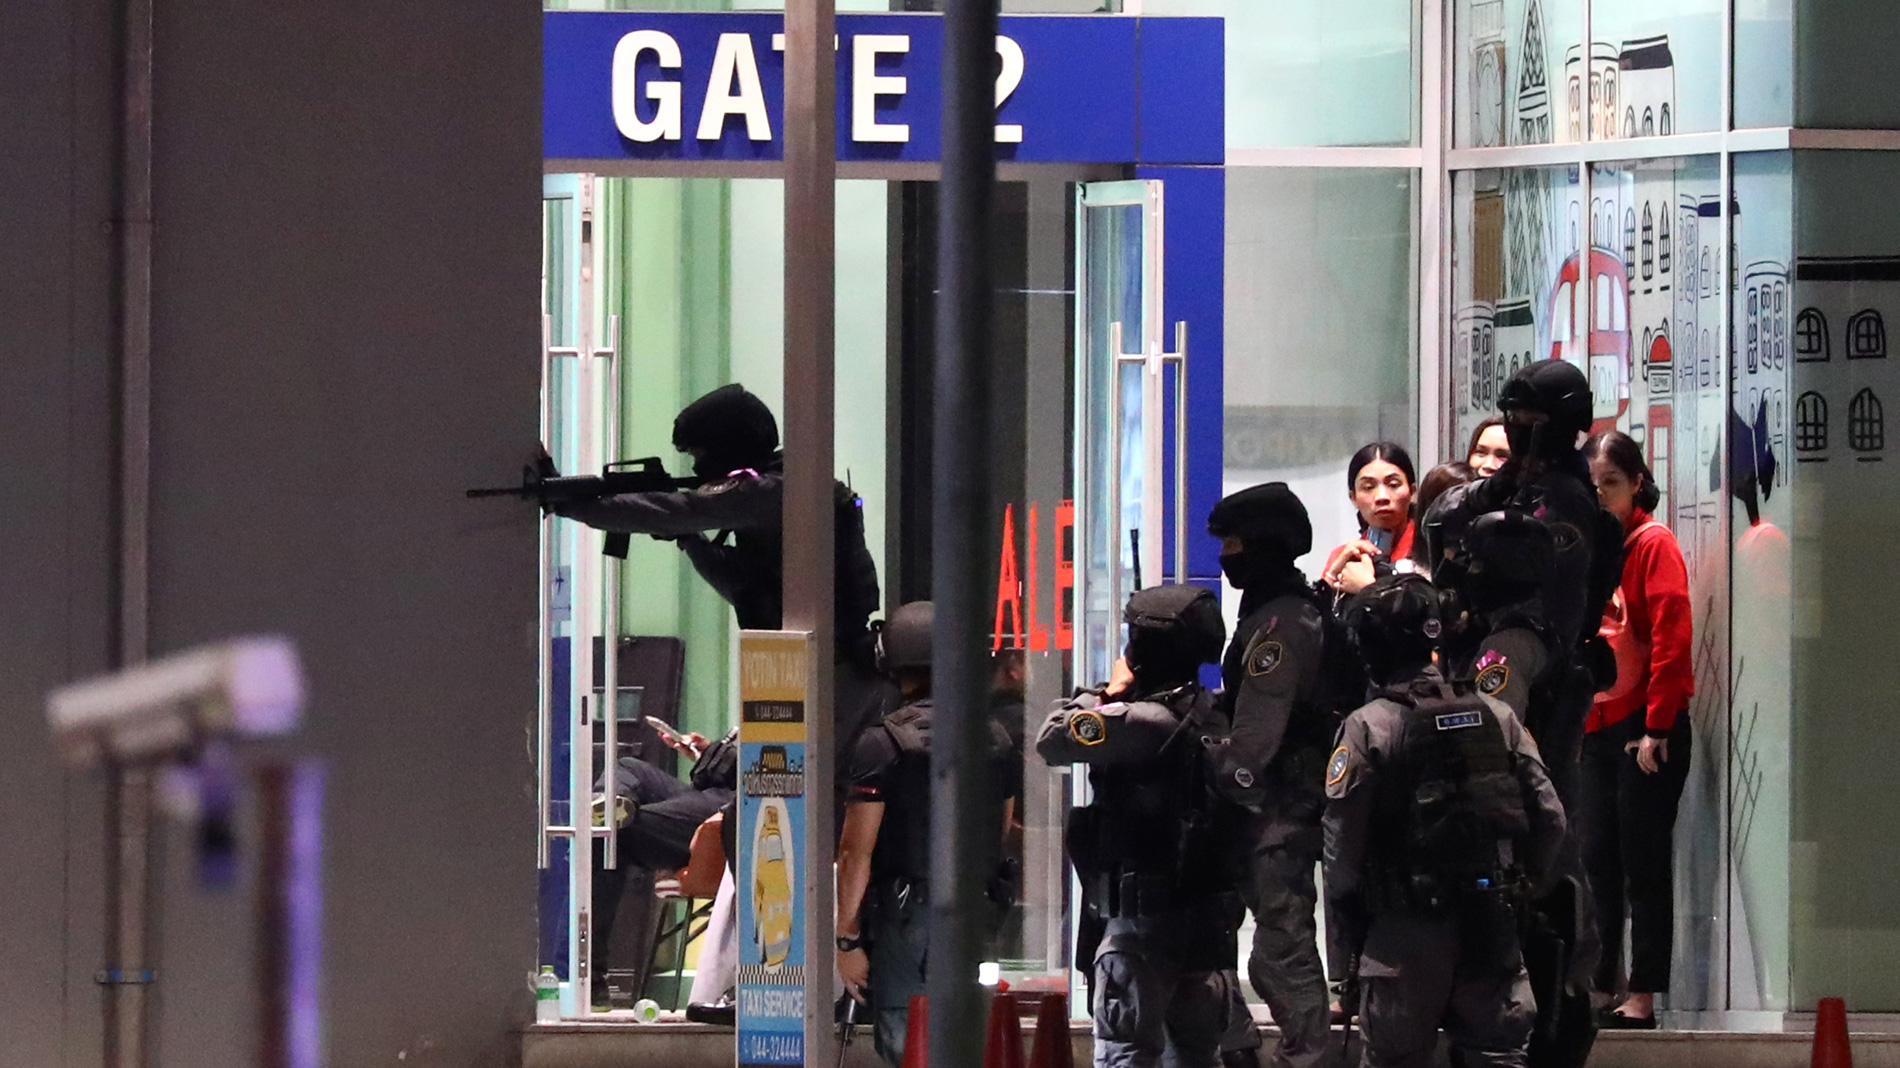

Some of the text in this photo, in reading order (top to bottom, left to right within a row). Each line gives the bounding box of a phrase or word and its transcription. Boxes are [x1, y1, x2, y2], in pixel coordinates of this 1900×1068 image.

[611, 29, 910, 143] GAE
[741, 989, 804, 1018] TAXI SERVICE
[751, 1034, 801, 1061] 044-324444
